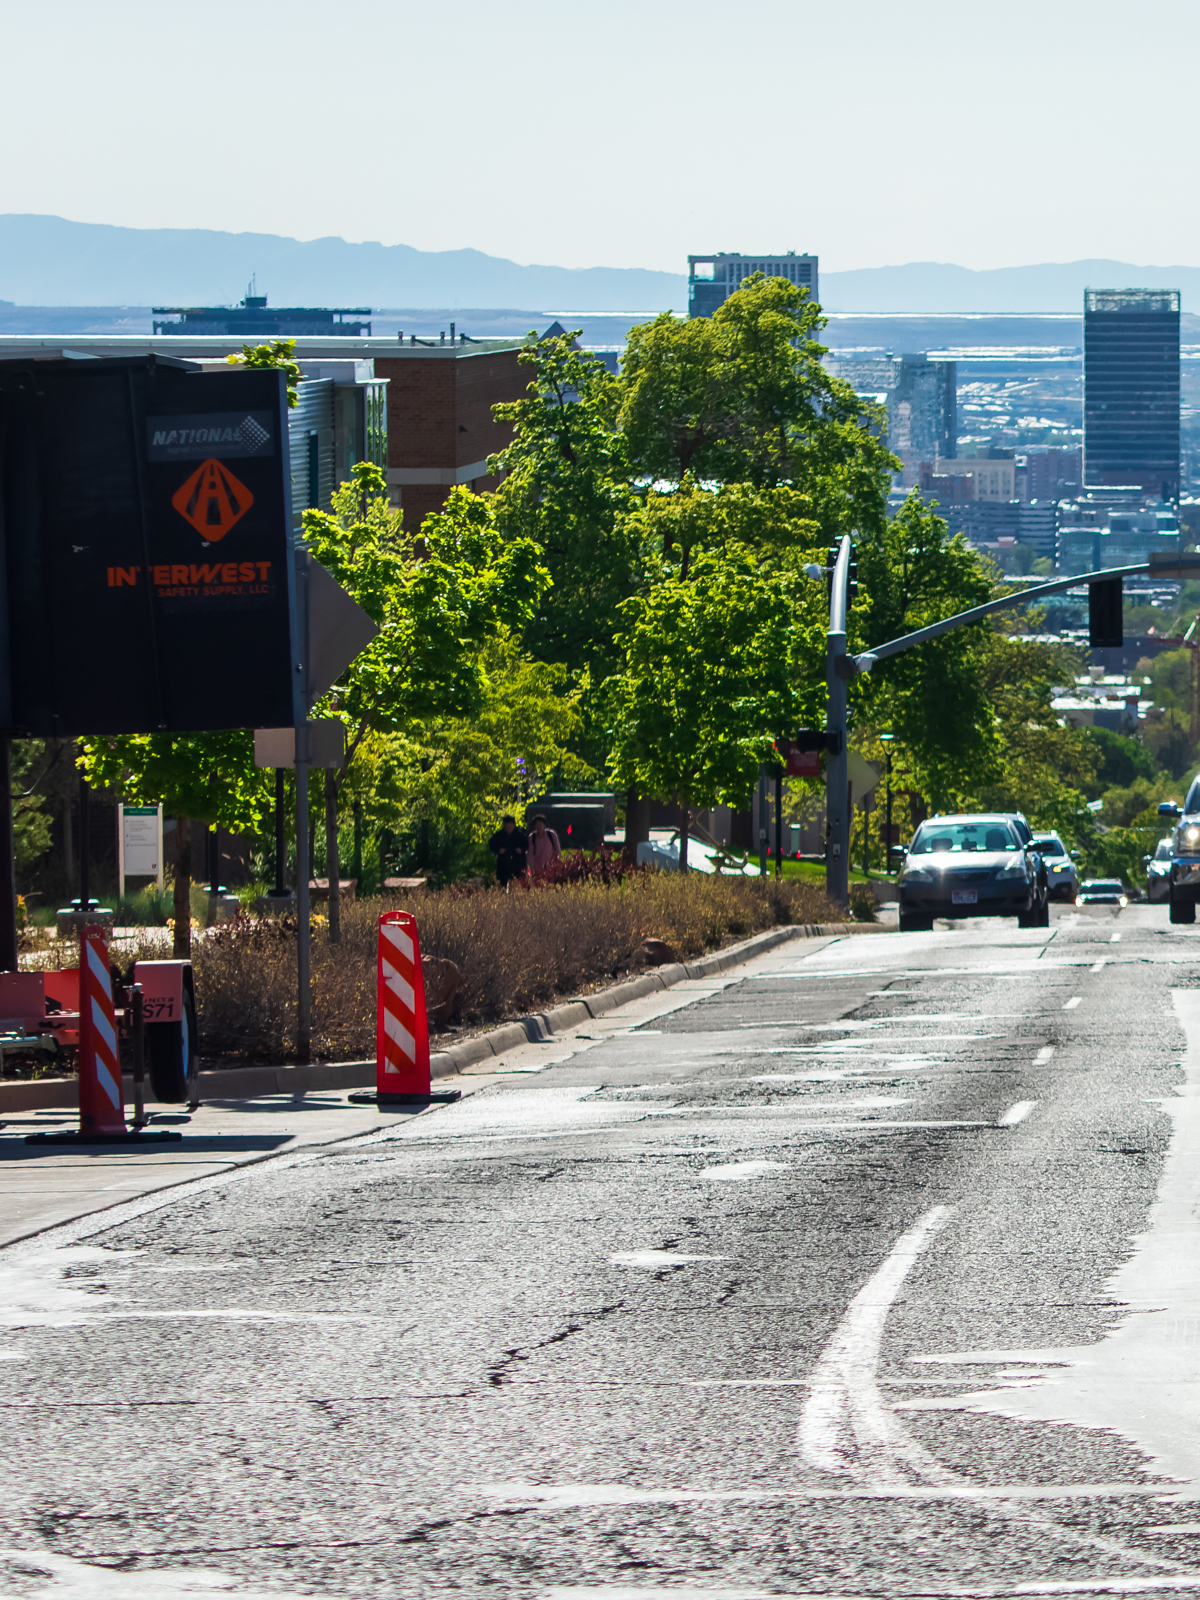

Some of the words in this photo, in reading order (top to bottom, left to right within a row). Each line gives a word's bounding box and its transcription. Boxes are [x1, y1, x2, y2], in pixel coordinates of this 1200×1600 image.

[153, 427, 243, 445] NATIONAL
[107, 561, 271, 587] INERWEST
[158, 587, 199, 597] SAFETY
[249, 584, 268, 594] LLC
[143, 1003, 174, 1019] S71
